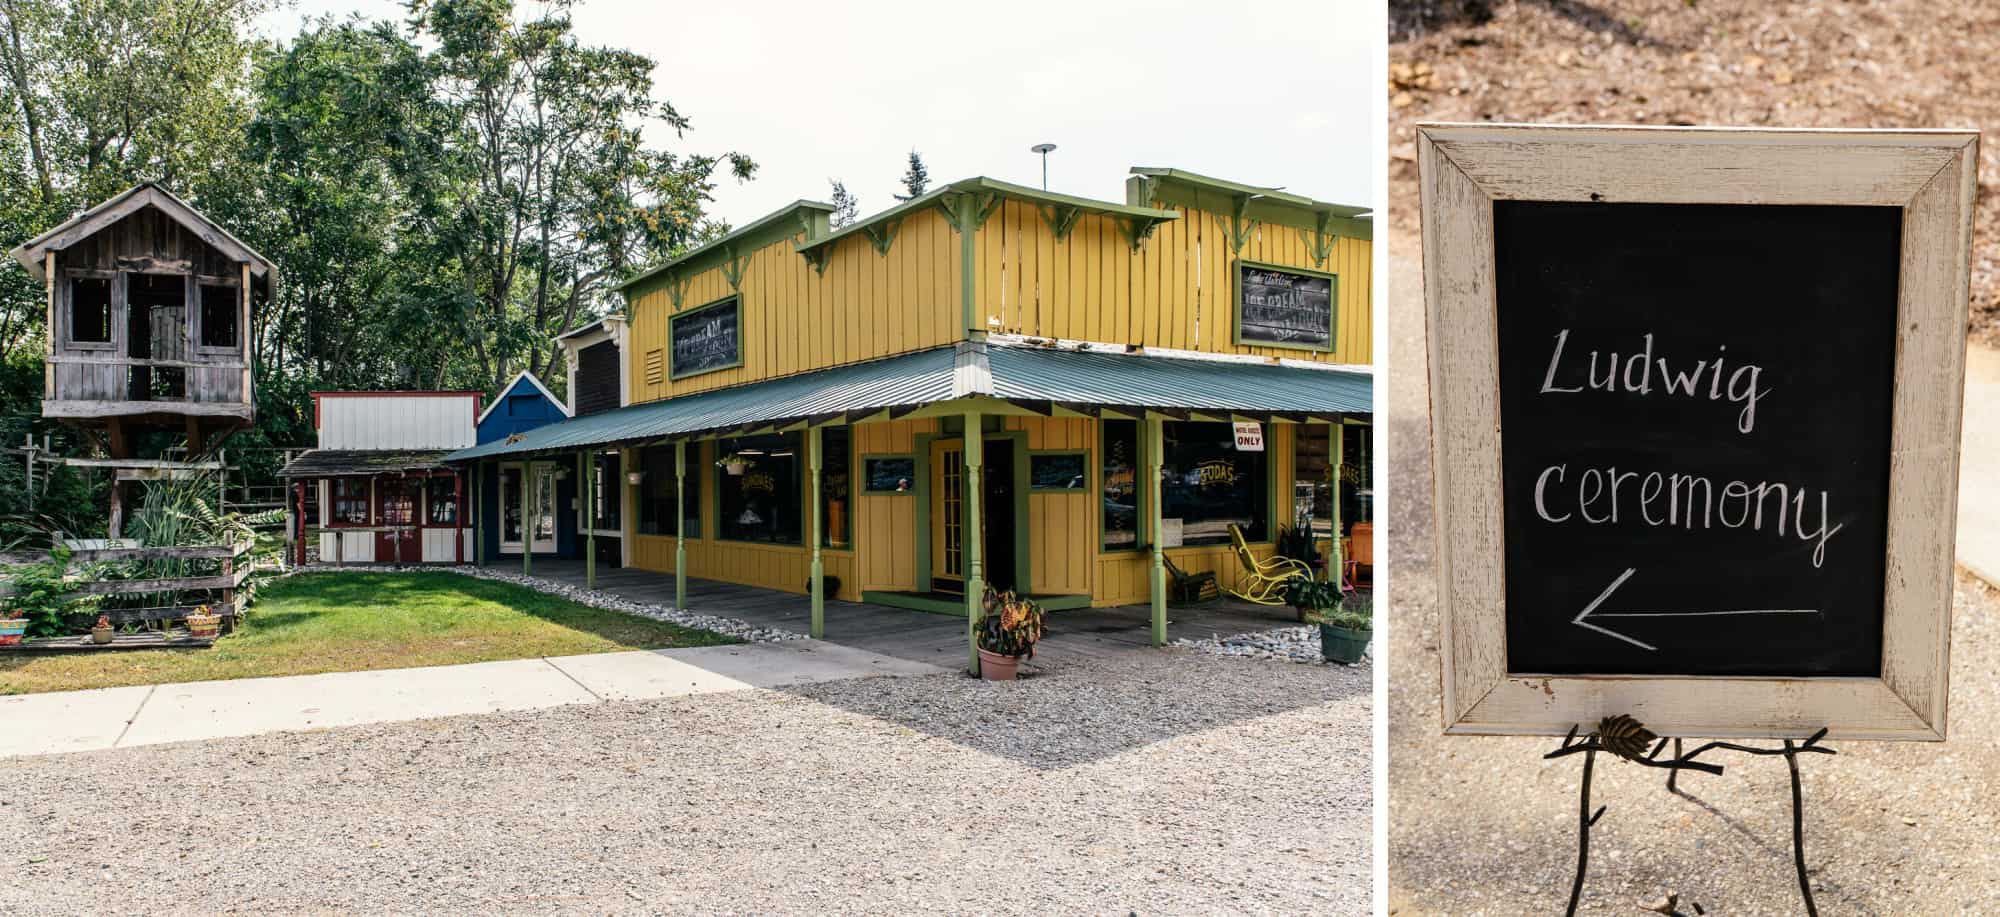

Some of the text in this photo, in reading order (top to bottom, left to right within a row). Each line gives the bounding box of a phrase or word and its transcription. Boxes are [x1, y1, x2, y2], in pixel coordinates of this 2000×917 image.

[1540, 329, 1771, 434] Ludwig
[1238, 437, 1260, 446] ONLY
[1200, 465, 1233, 482] SODAS
[1534, 463, 1843, 569] ceremony
